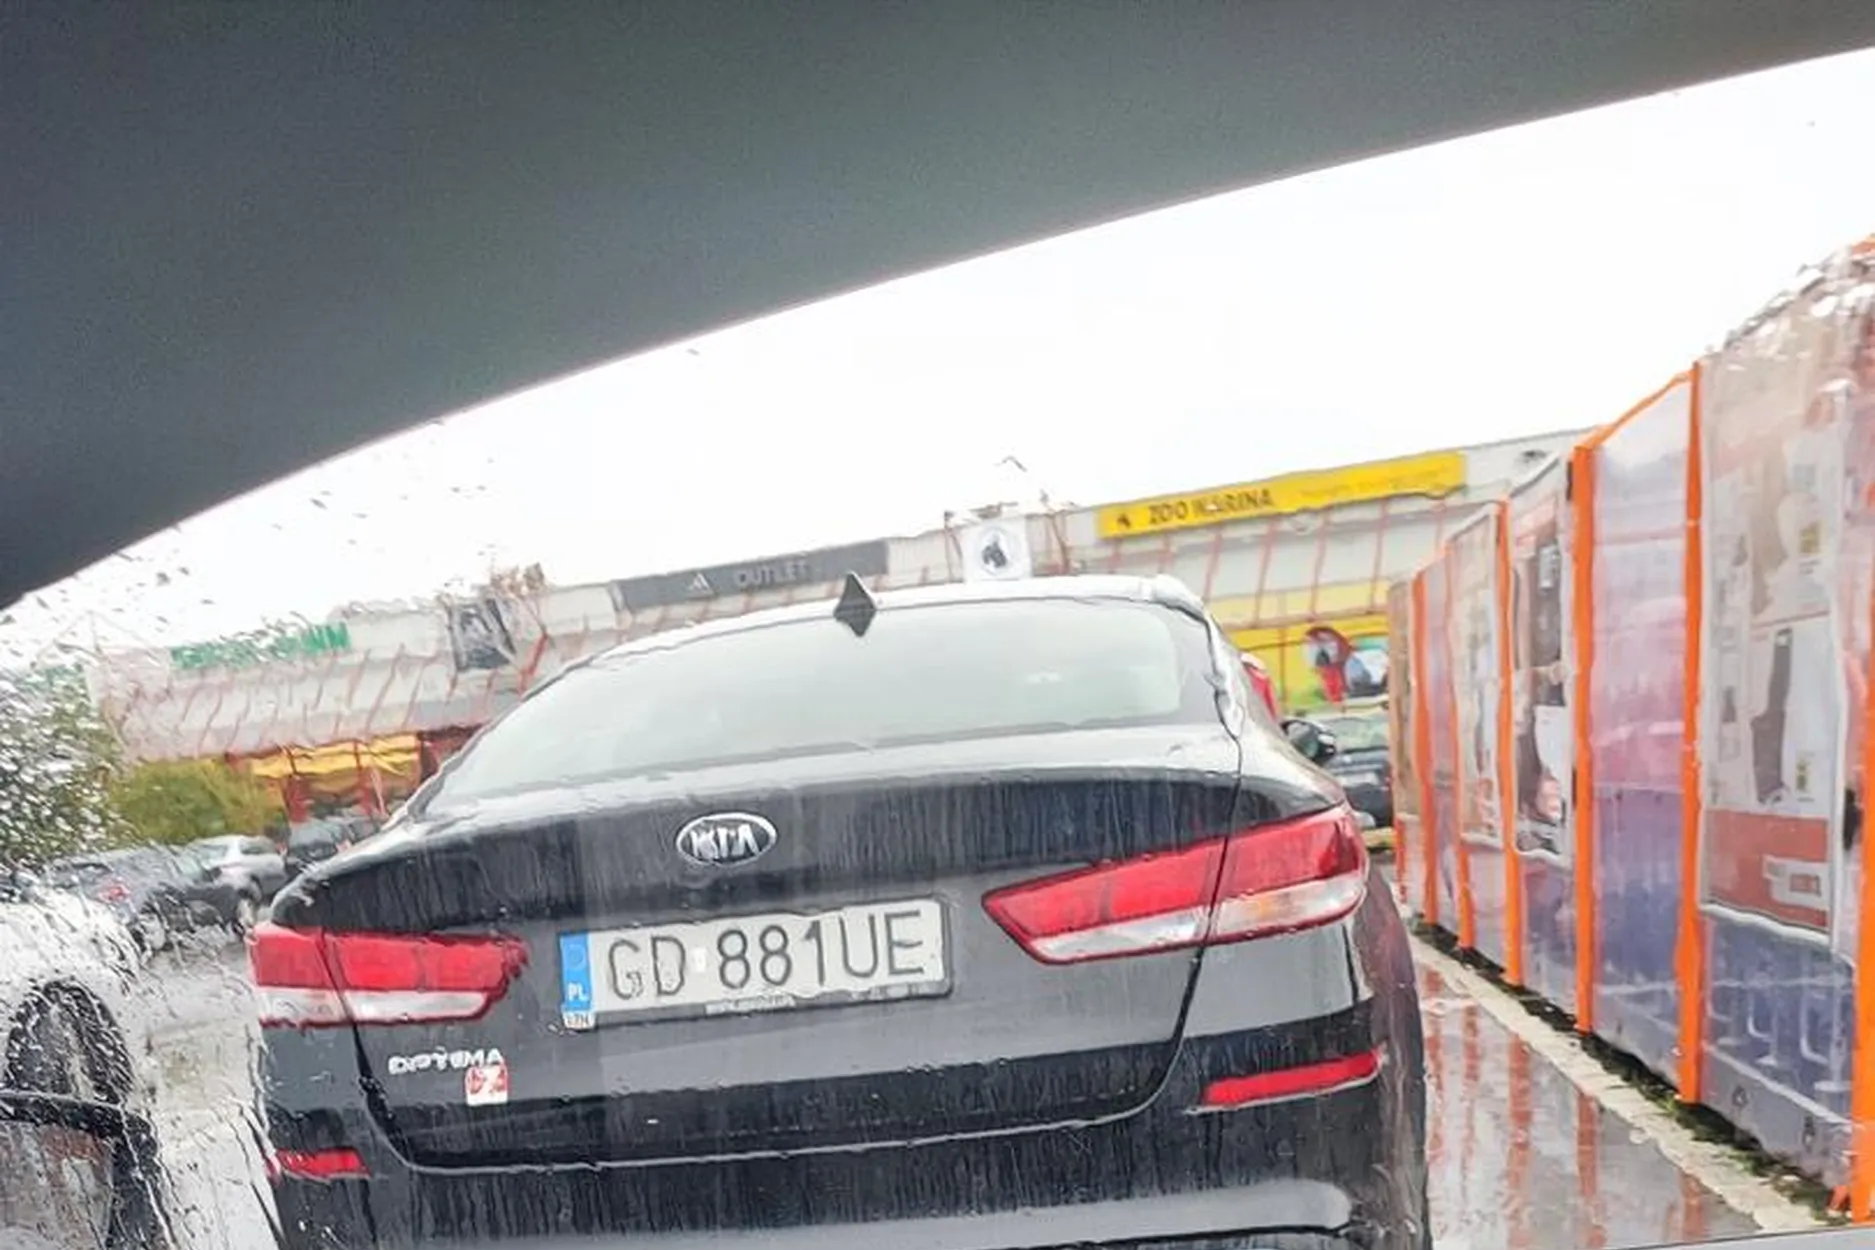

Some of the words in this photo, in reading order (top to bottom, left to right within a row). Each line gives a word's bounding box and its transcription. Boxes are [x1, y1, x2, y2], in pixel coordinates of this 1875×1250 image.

[1149, 500, 1188, 524] ZOO
[735, 560, 808, 587] OUTLET
[690, 824, 760, 859] KIA
[609, 936, 686, 999] GD
[716, 910, 924, 989] 881UE
[568, 982, 589, 1001] PL
